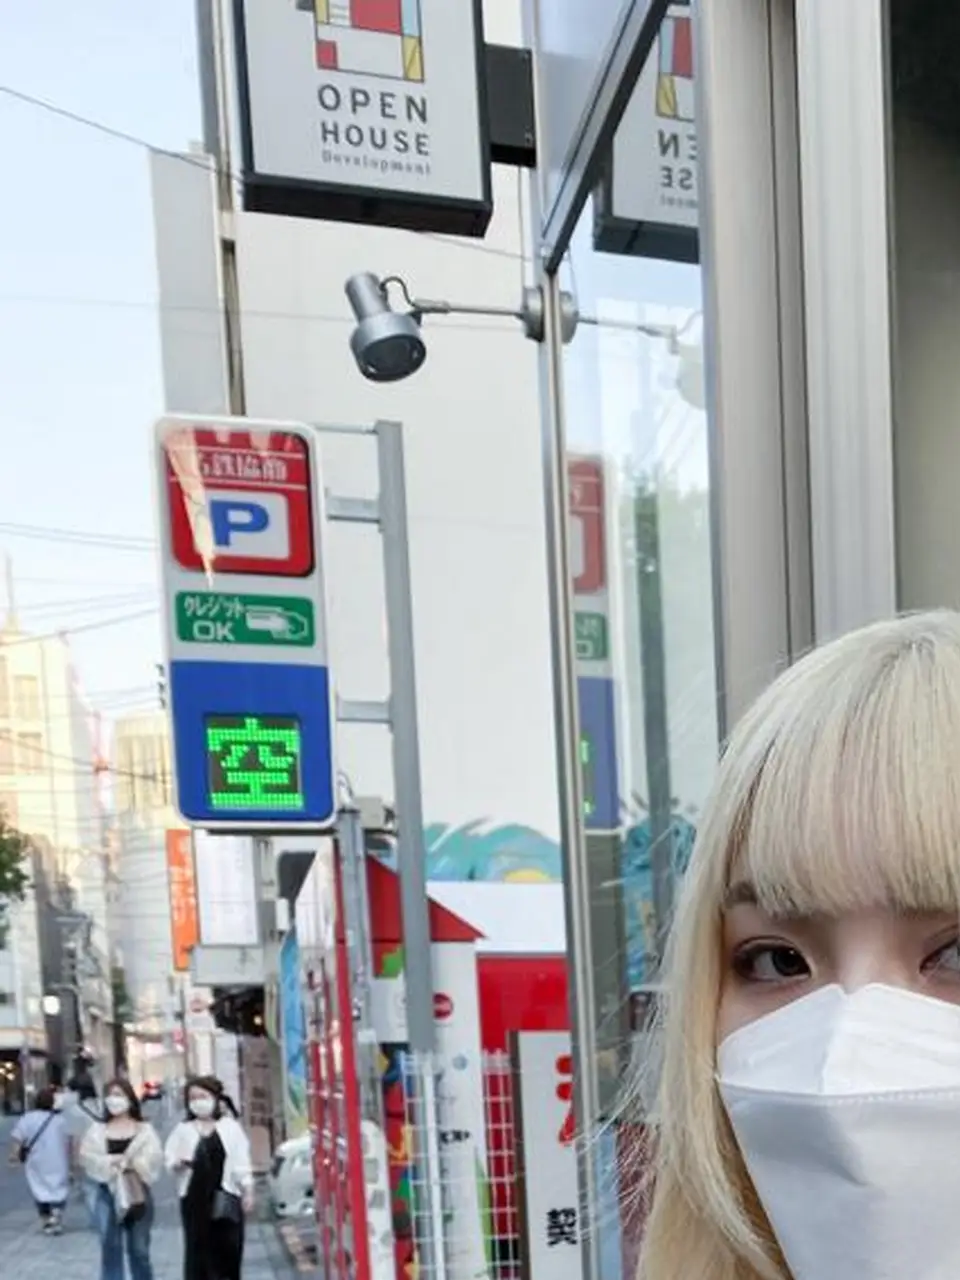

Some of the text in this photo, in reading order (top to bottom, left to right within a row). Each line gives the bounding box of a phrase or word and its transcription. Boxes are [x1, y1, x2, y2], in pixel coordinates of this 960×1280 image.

[318, 84, 428, 124] OPEN
[321, 121, 429, 156] HOUSE
[321, 150, 431, 174] Development
[210, 499, 270, 546] P
[183, 594, 245, 618] クレジット
[192, 619, 236, 641] OK
[207, 717, 303, 808] 空
